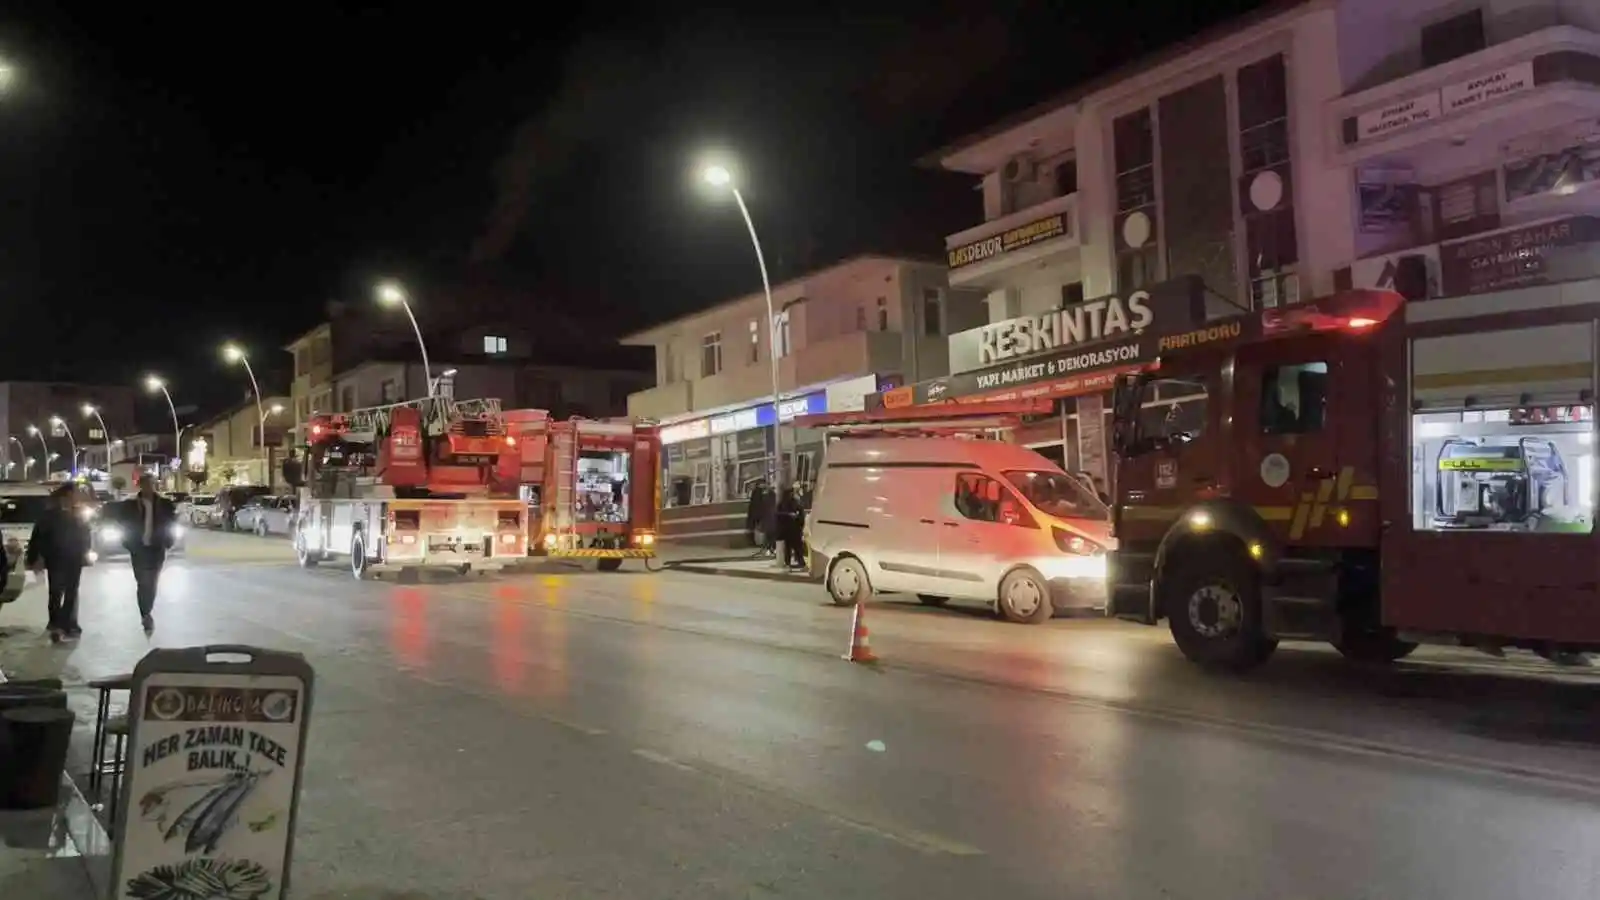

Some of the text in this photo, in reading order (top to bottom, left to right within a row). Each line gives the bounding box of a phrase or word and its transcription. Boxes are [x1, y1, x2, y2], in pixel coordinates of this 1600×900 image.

[976, 344, 1140, 389] YAPI MARKET & DEKORASYON
[143, 726, 287, 768] HER ZAMAN TAZE
